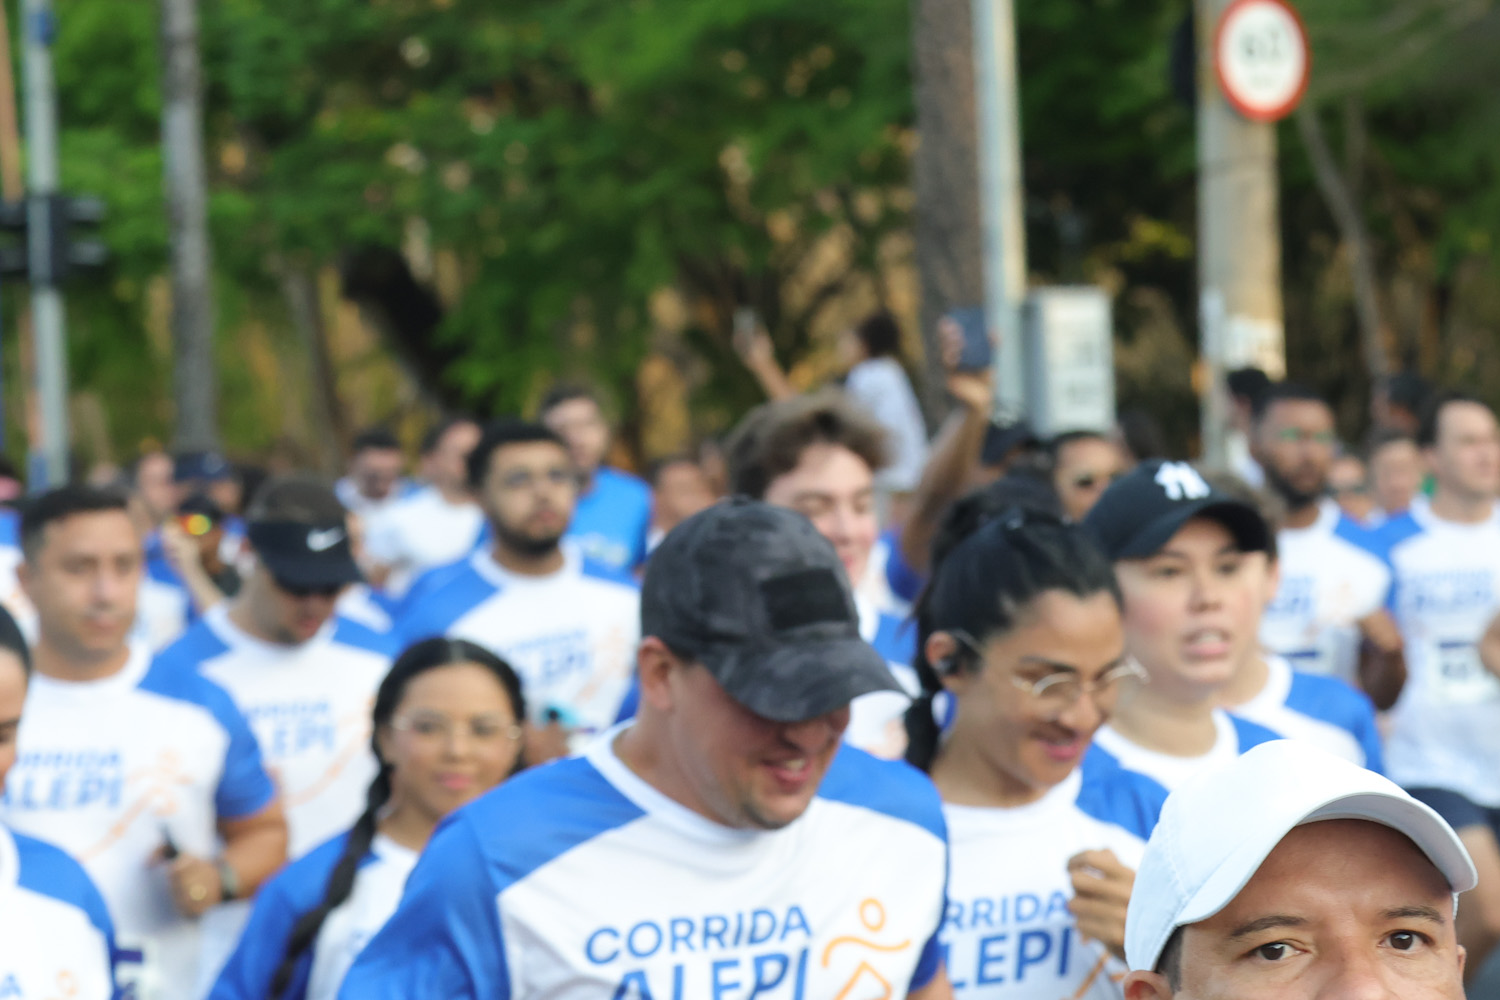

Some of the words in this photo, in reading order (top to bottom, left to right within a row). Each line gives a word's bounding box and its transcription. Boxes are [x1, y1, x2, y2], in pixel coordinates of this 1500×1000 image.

[584, 904, 813, 965] CORRIDA
[946, 889, 1070, 930] RRIDA
[946, 925, 1073, 989] LEPI
